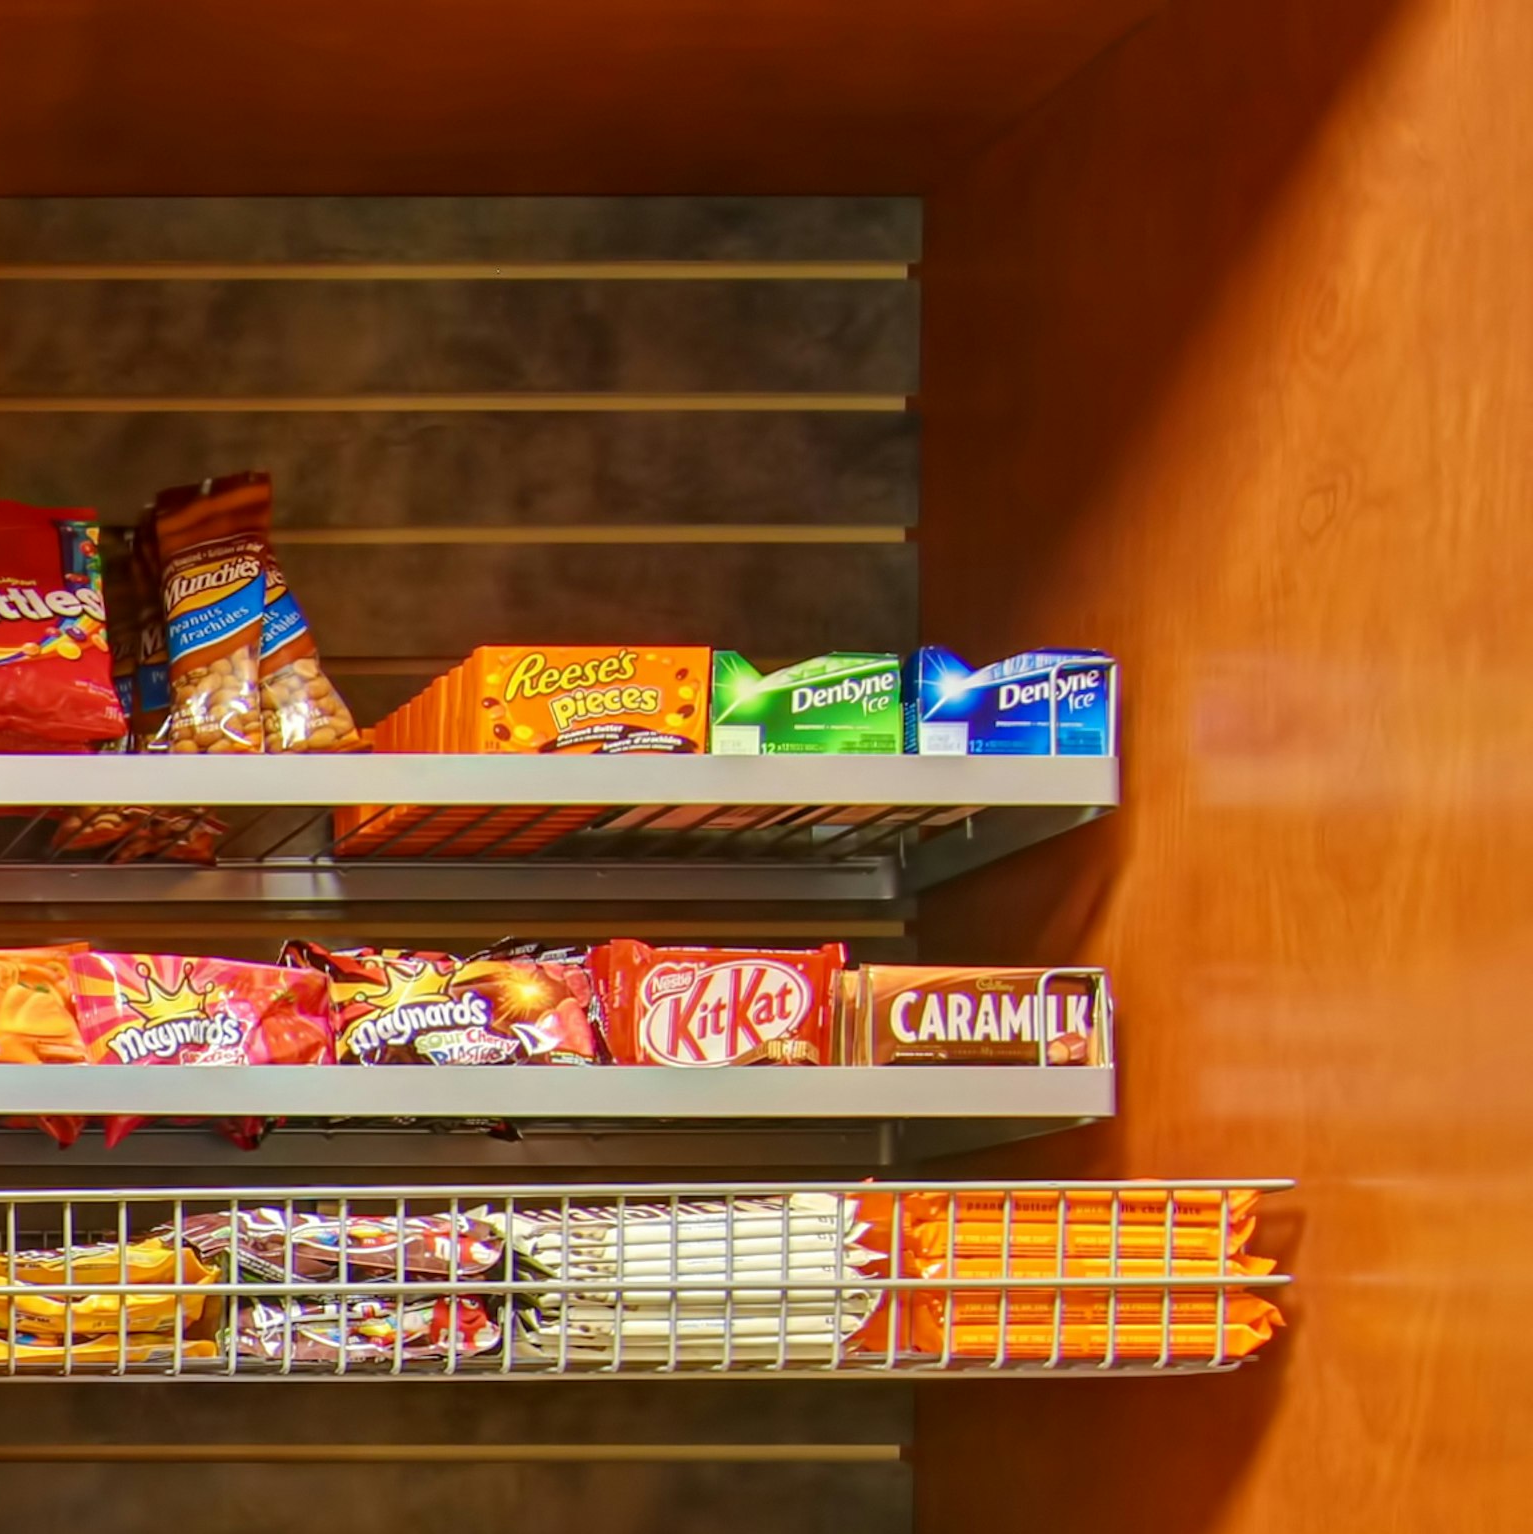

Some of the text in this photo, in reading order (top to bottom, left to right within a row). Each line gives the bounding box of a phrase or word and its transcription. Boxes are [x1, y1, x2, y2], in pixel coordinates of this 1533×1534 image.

[164, 557, 261, 612] Munchies
[169, 604, 224, 638] Peanuts
[179, 606, 250, 647] Arachides
[790, 669, 895, 714] Dentyne
[997, 669, 1101, 712] Dentyne
[761, 742, 777, 755] 12
